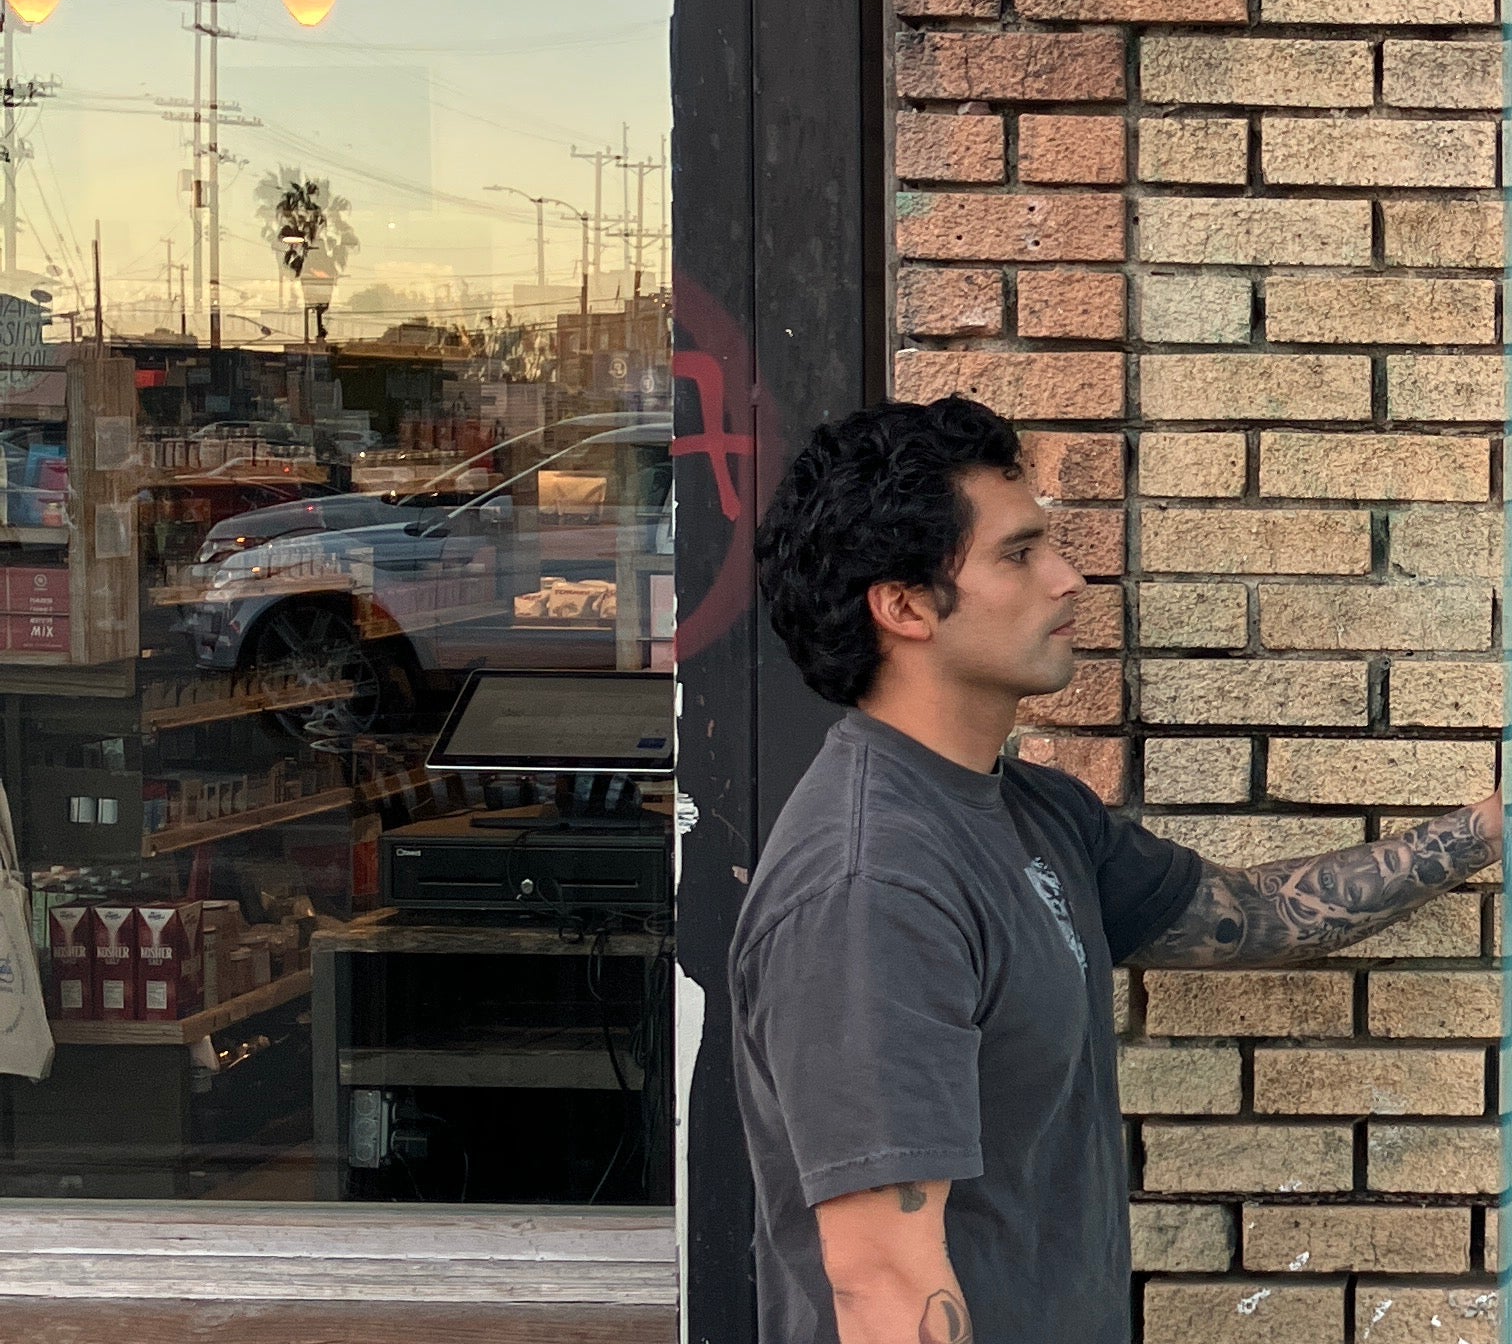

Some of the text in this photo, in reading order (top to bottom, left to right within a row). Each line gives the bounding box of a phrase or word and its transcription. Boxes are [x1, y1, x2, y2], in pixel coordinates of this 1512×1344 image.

[30, 625, 54, 638] MIX
[96, 946, 130, 959] KOSHER
[140, 946, 173, 960] KOSHER
